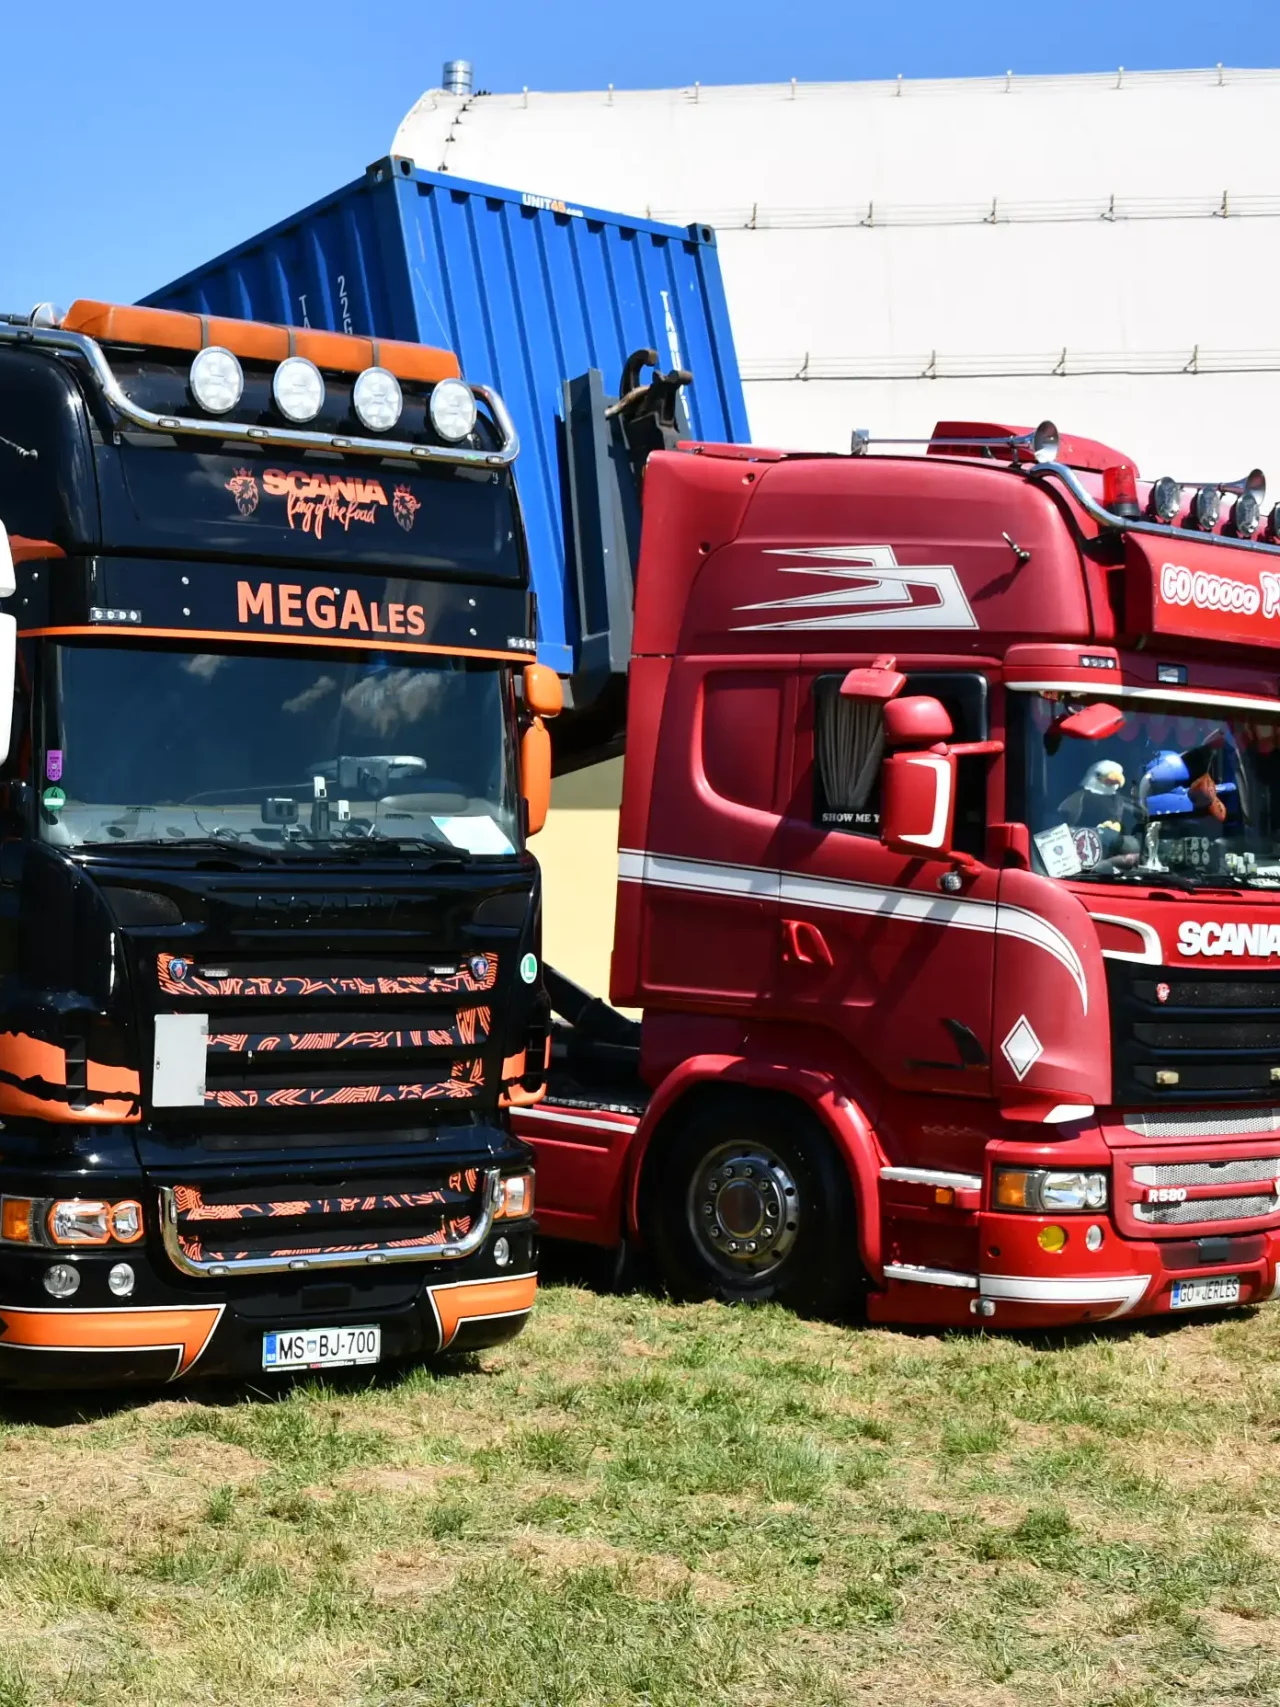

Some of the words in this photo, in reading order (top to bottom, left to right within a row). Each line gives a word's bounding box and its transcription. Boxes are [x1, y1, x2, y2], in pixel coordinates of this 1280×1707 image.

[262, 468, 388, 506] SCANIA
[237, 580, 426, 636] MEGALES
[822, 813, 853, 822] SHOW
[855, 813, 871, 822] ME
[1180, 1283, 1195, 1302] GO
[1202, 1278, 1238, 1301] JERLES
[279, 1336, 305, 1360] MS
[319, 1330, 376, 1357] BJ-700
